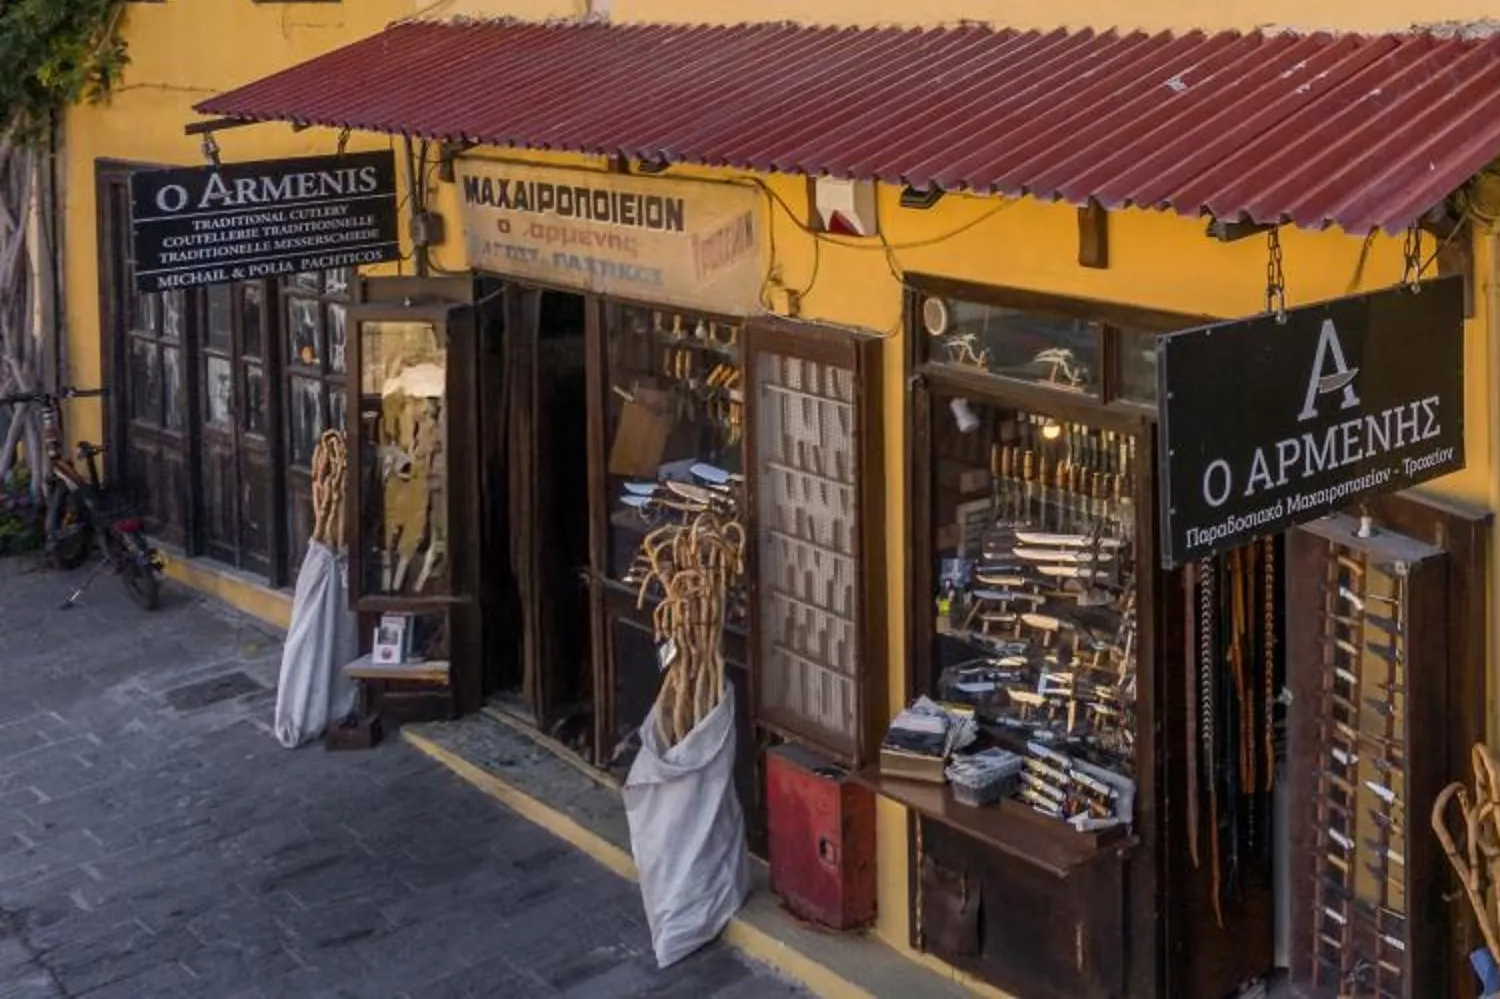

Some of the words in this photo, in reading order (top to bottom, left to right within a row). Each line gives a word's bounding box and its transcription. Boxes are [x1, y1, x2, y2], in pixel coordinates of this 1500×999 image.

[200, 166, 377, 208] ARMENIS
[463, 175, 685, 232] ΜΑΧΑΙΡΟΠΟΙΕΙΟΝ
[162, 228, 258, 248] COUTELLERIE
[263, 215, 375, 237] TRADITIONNELLE
[192, 211, 286, 231] TRADITIONAL
[289, 204, 349, 220] CUTLERY
[158, 269, 228, 289] MICHAIL
[249, 261, 293, 276] POLIA
[302, 250, 383, 270] PACHTICOS
[159, 241, 270, 264] TRADITIONELLE
[1244, 396, 1441, 497] ΑΡΜΕΝΗΣ
[1287, 466, 1392, 516] Μαχαιροποιείον
